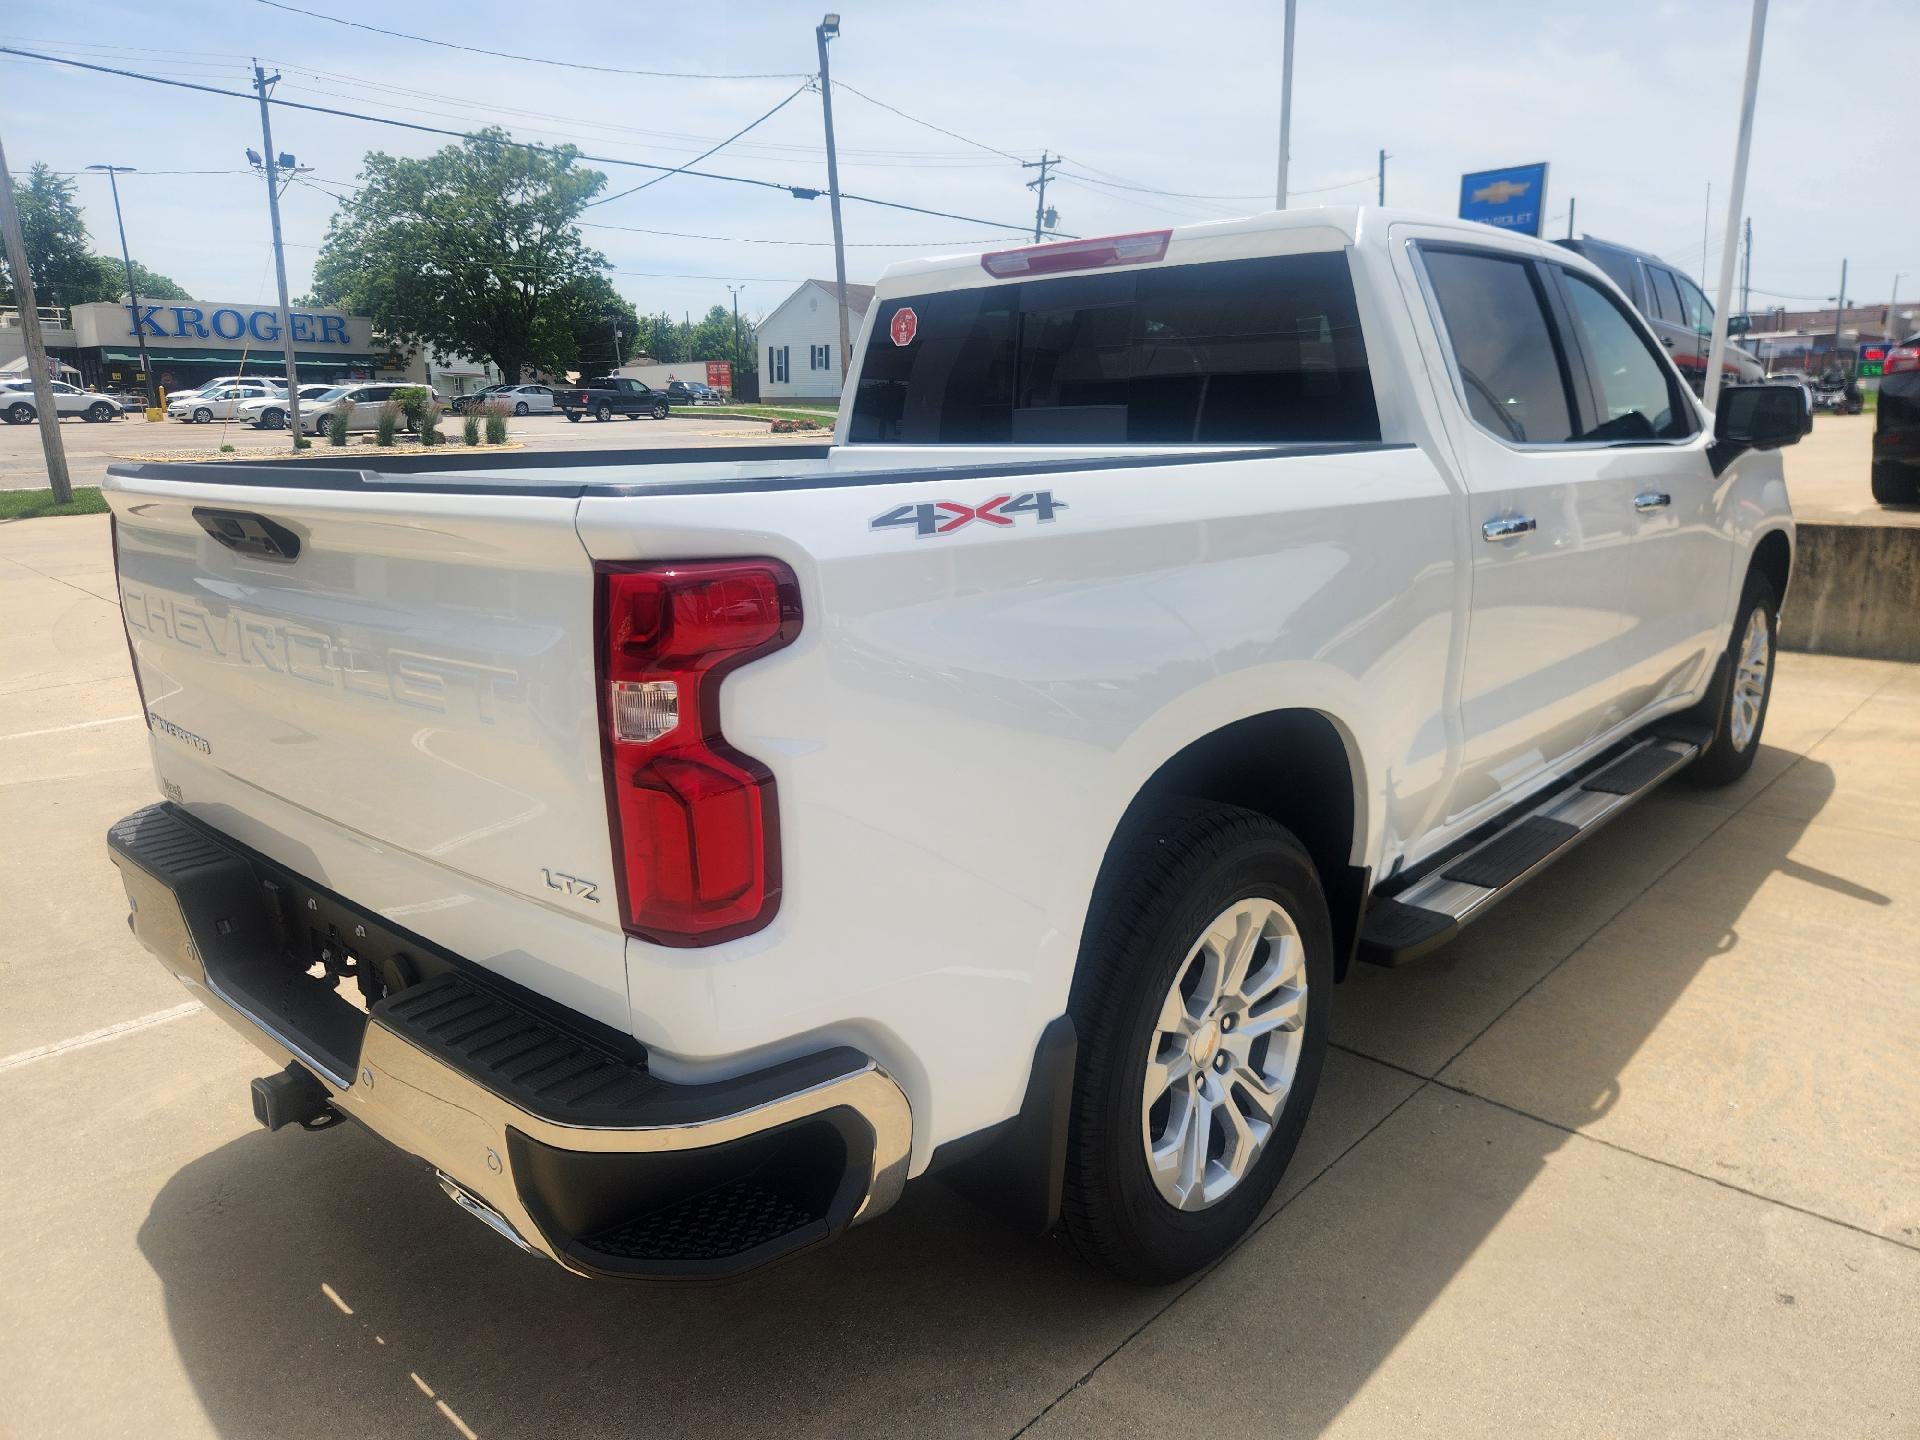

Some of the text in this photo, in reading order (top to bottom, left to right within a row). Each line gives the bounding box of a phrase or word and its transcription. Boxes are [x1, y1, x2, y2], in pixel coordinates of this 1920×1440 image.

[1468, 213, 1534, 226] EVROLET
[125, 304, 350, 345] KROGER
[121, 588, 519, 726] CHEVROLET
[540, 868, 601, 904] LTZ
